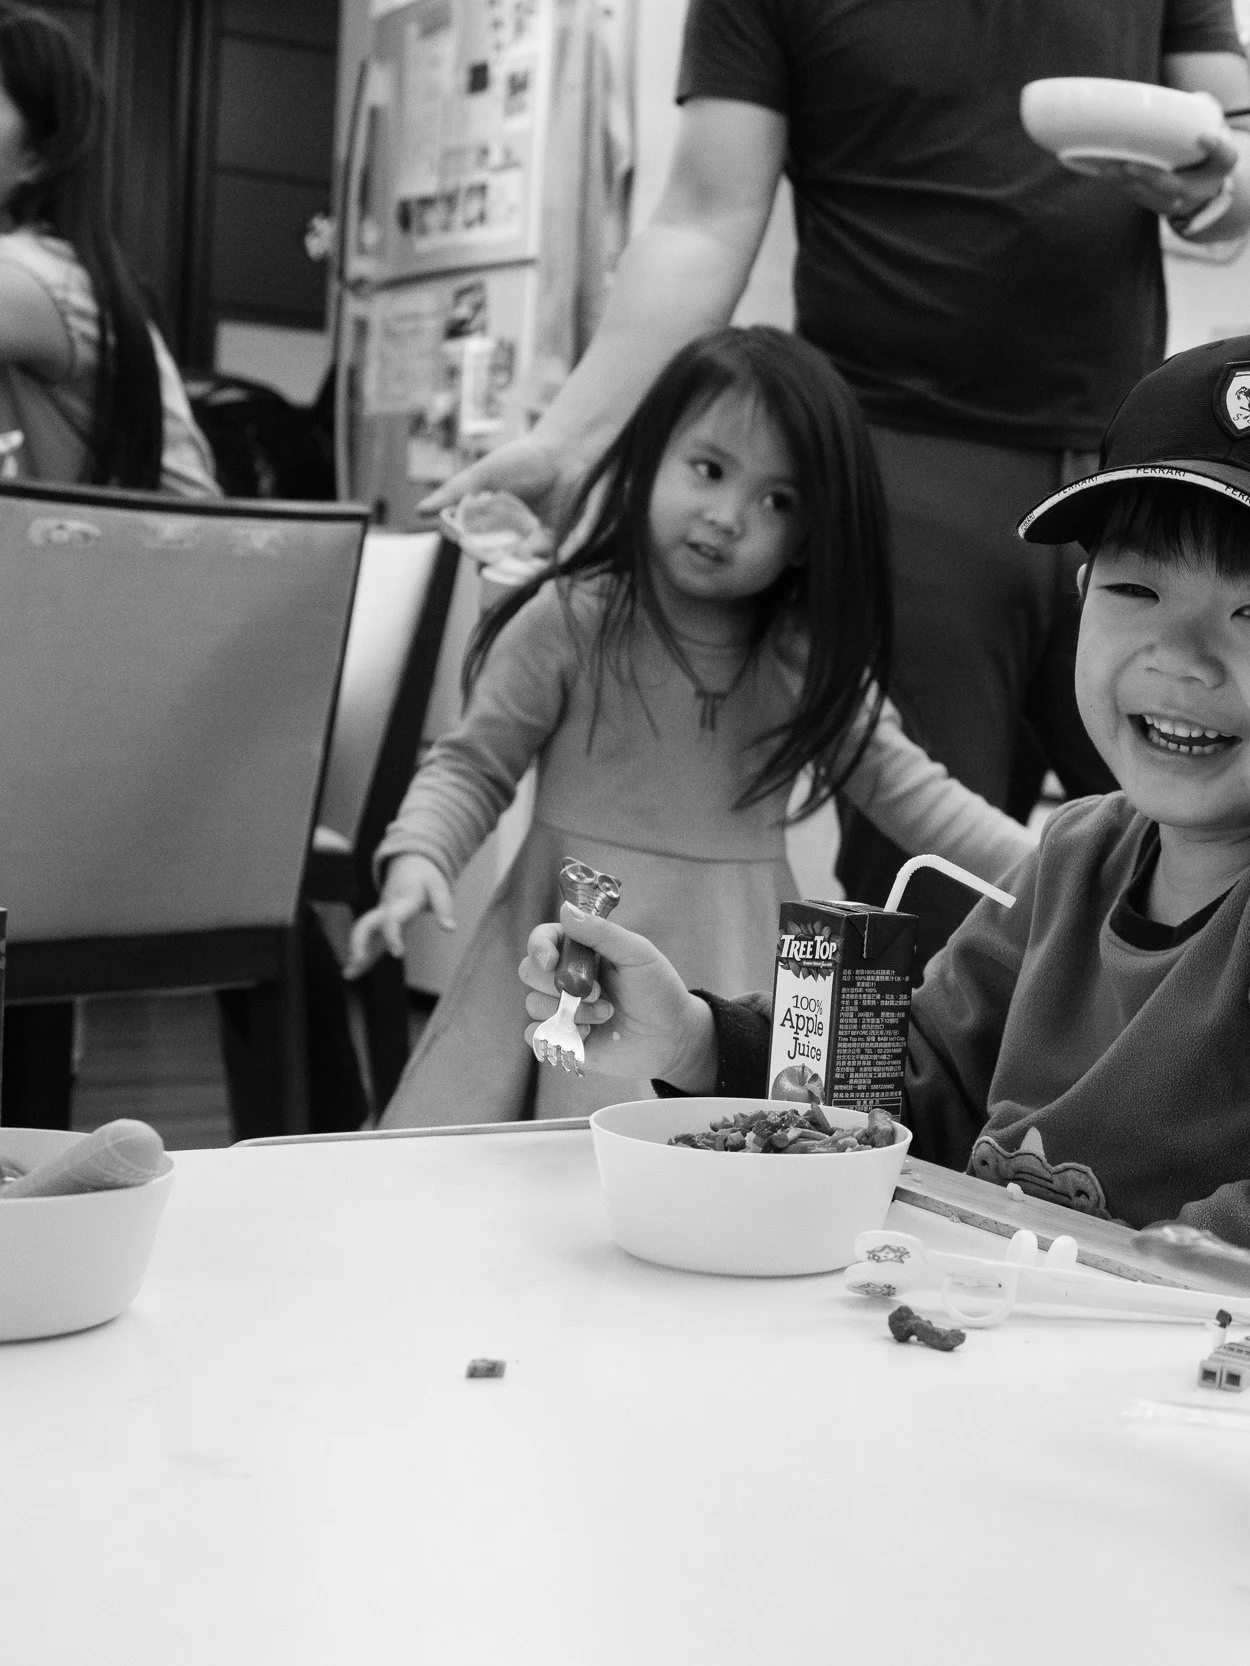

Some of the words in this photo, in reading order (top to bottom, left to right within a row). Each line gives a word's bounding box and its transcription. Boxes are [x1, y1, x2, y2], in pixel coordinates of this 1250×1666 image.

[1136, 467, 1187, 477] FERRARI
[792, 994, 824, 1016] 100%
[780, 1007, 824, 1038] Apple
[788, 1036, 822, 1061] Juice
